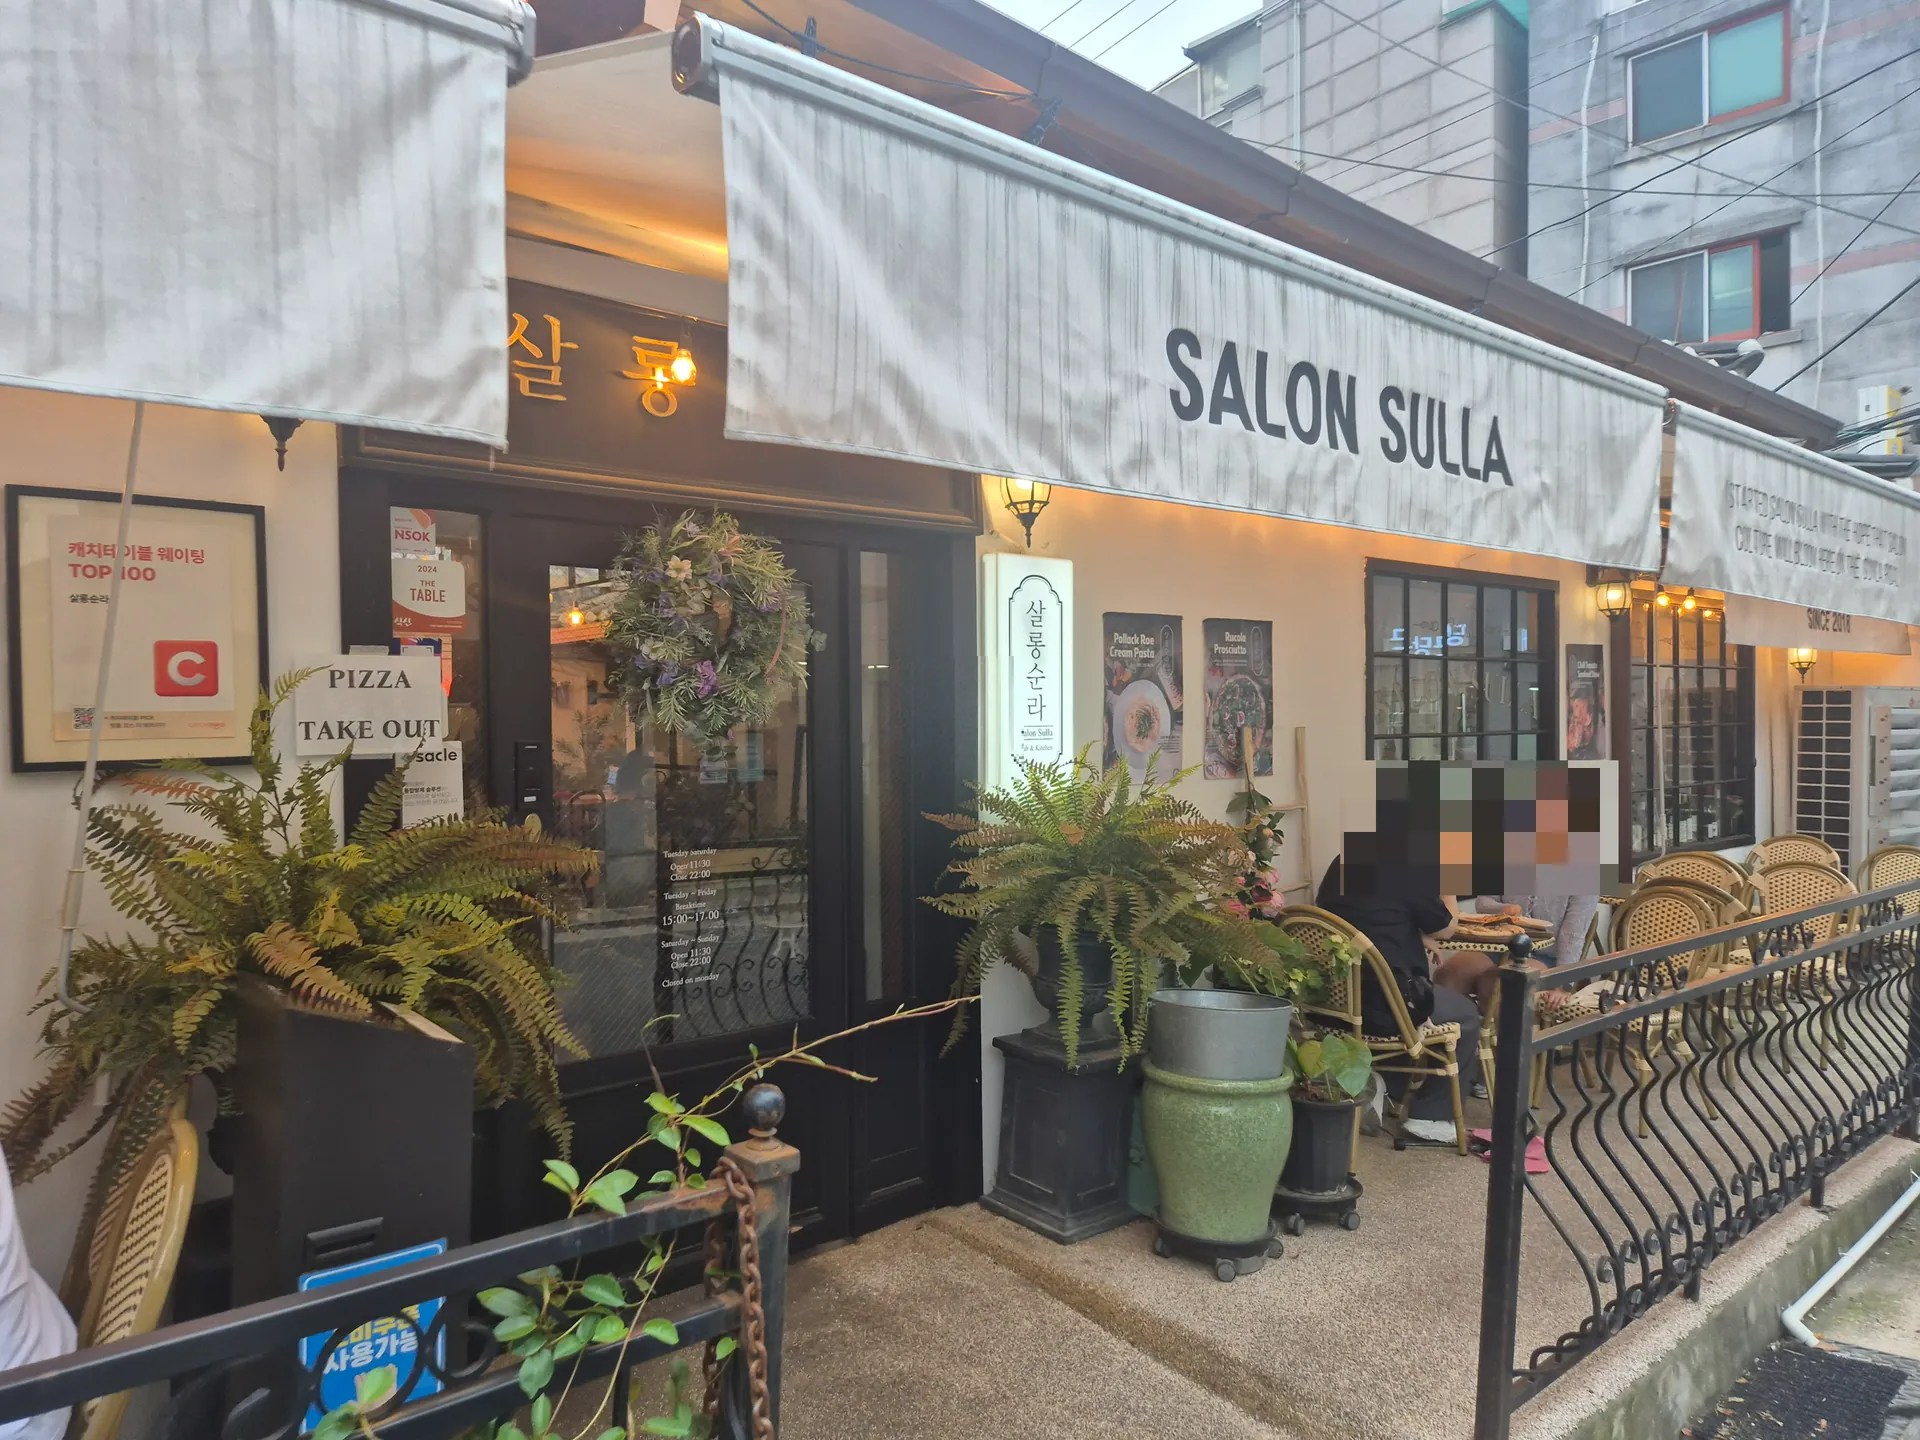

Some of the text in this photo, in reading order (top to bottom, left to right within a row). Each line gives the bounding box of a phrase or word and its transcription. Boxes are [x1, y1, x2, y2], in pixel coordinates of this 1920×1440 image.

[1166, 328, 1514, 486] SALON SULLA
[394, 529, 431, 543] NSOK
[157, 546, 206, 565] 웨이팅
[68, 563, 156, 581] TOP 100
[417, 565, 437, 573] 2024
[410, 588, 446, 603] TABLE
[1807, 606, 1829, 631] SINCE
[1140, 634, 1155, 645] Roe
[1225, 632, 1247, 642] Rucola
[1110, 646, 1155, 658] Cream Pasta
[1214, 644, 1247, 655] Prosciutto
[1026, 599, 1047, 722] 살롱순라
[329, 669, 412, 689] PIZZA
[298, 719, 440, 741] TAKE OUT
[663, 850, 689, 858] Tuesday
[670, 859, 711, 871] Open 11:30
[689, 869, 711, 879] 22:00
[663, 891, 689, 900] Tuesday
[697, 888, 717, 896] Friday
[661, 938, 689, 948] Saturday
[697, 933, 719, 943] Sunday
[671, 946, 711, 961] Open 11:30
[671, 956, 711, 969] Close 22:00
[662, 977, 684, 988] Closed
[695, 972, 719, 983] monday
[333, 1304, 420, 1346] 비쿠폰
[324, 1331, 419, 1374] 사용가능
